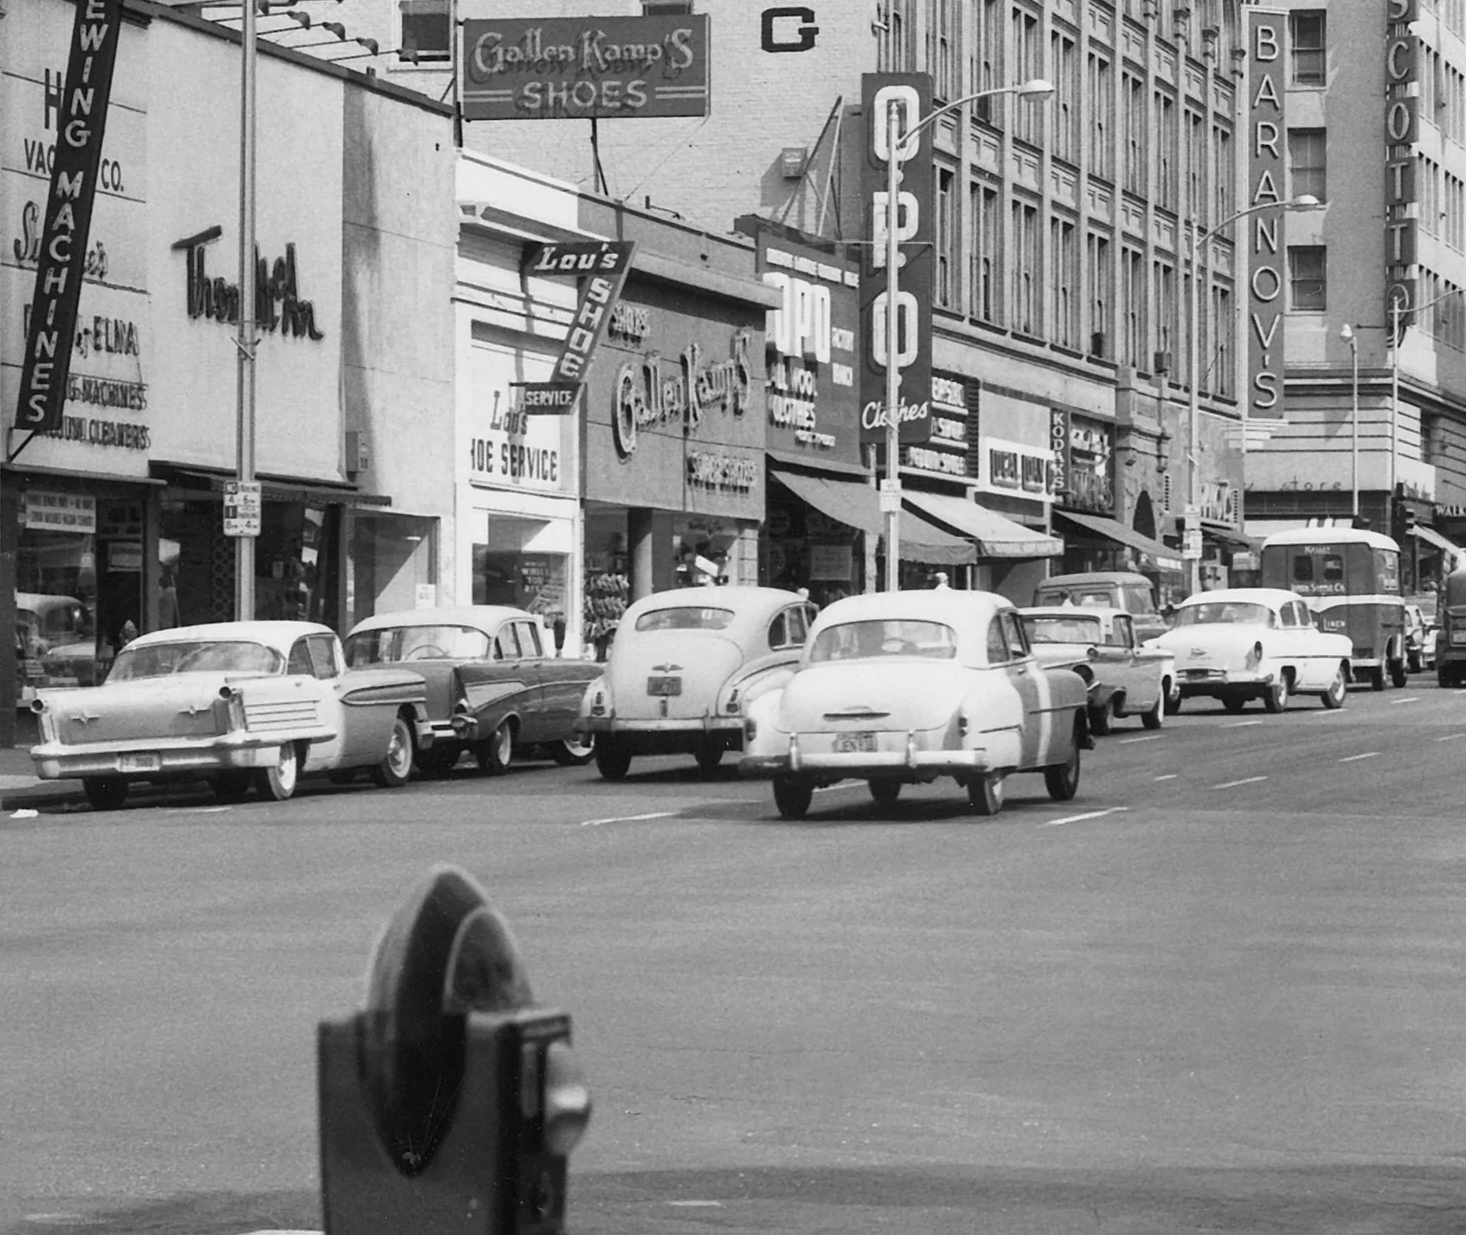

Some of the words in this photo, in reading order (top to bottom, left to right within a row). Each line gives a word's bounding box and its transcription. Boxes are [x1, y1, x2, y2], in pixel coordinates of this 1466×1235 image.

[522, 79, 647, 109] SHOES
[1251, 24, 1281, 408] BARANOV'S
[533, 243, 619, 270] Lou's
[26, 170, 85, 423] MACHINES
[559, 277, 613, 379] SHOE
[525, 390, 573, 406] SERVICE
[862, 396, 929, 430] Clohes
[501, 442, 558, 482] SERVICE
[1052, 412, 1065, 489] KODAKS
